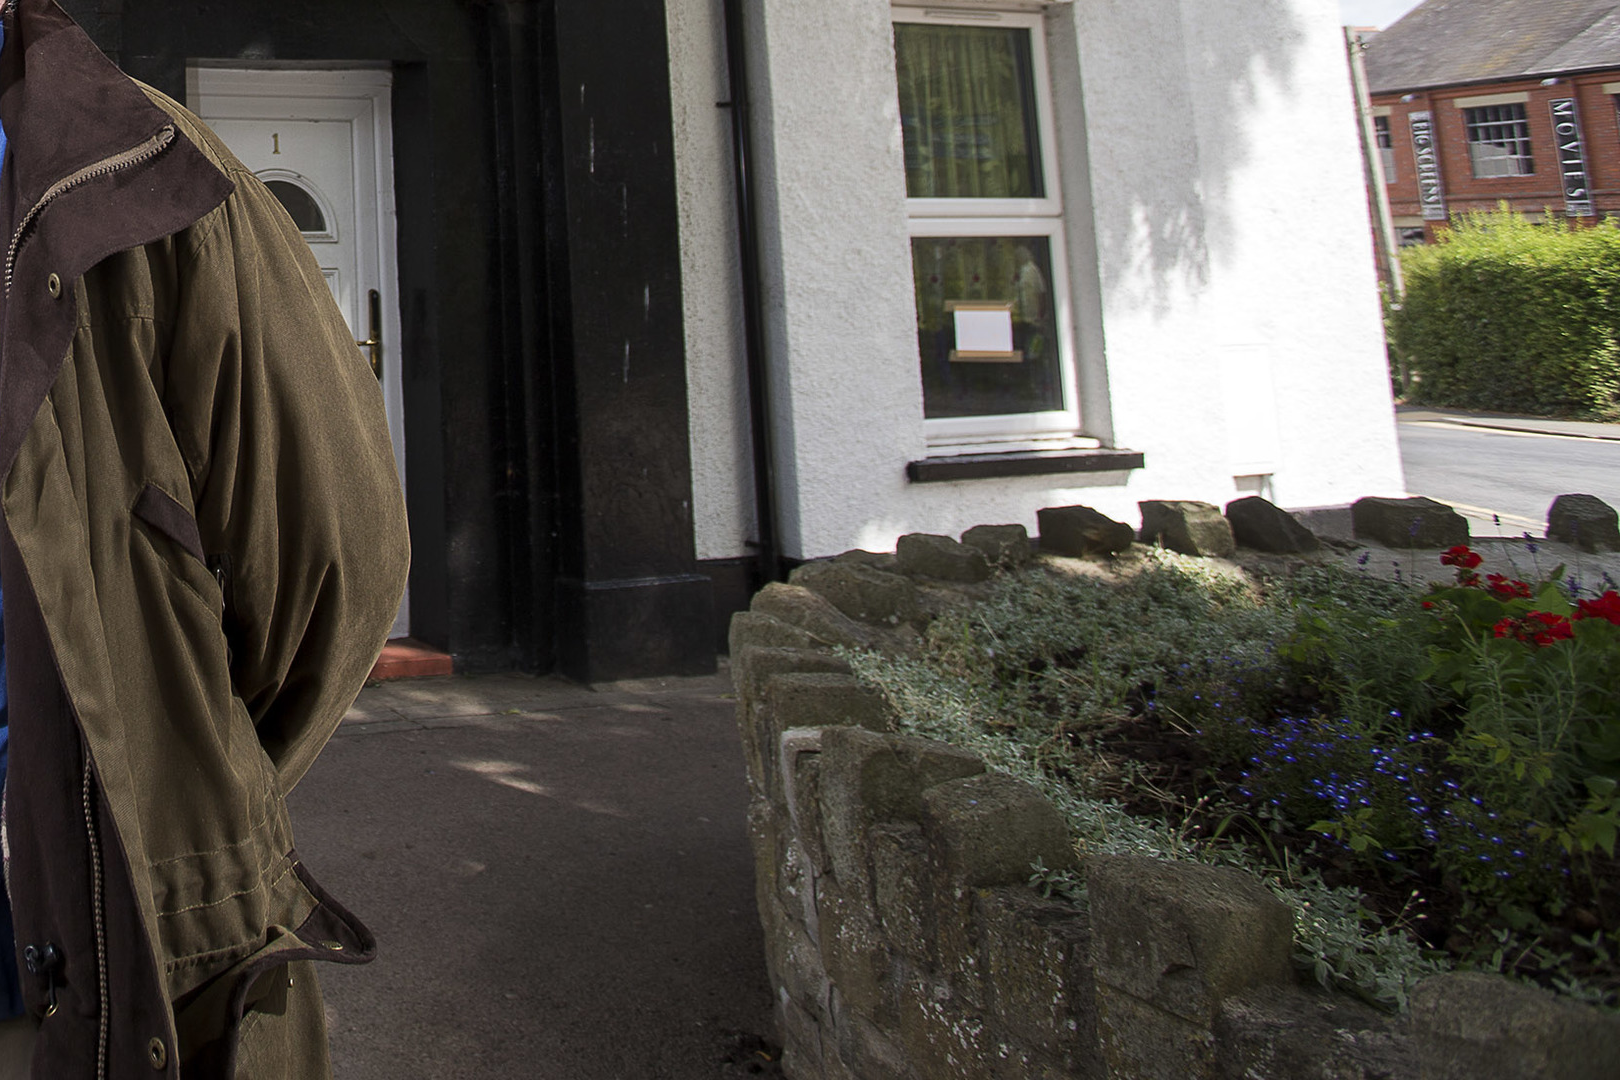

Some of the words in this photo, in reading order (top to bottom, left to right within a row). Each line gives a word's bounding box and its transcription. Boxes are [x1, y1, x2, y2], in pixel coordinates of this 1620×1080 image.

[272, 133, 281, 154] 1
[1411, 121, 1431, 146] BIG
[1553, 101, 1586, 197] MOVIES
[1416, 147, 1440, 203] SCREENS
